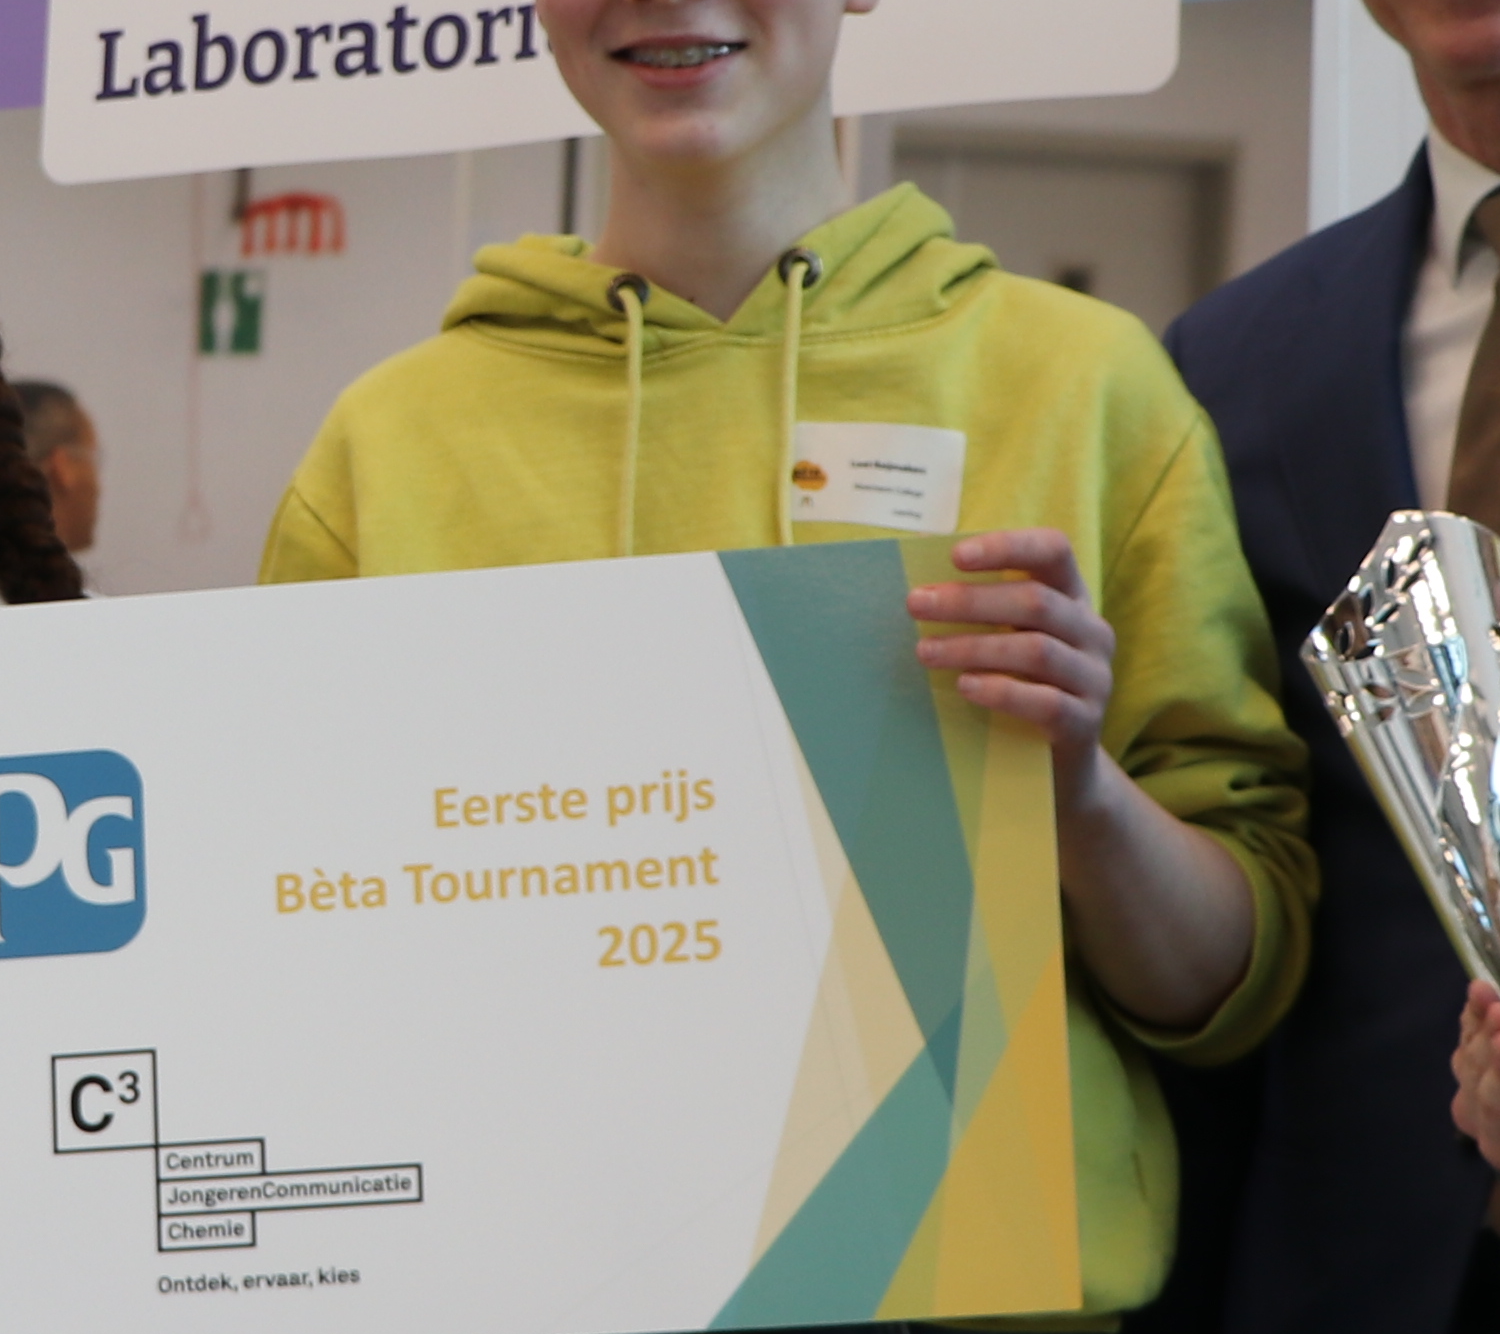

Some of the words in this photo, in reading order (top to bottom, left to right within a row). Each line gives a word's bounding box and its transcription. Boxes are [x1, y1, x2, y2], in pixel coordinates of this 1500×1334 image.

[434, 783, 588, 829] Eerste
[606, 769, 717, 828] prijs
[275, 868, 388, 914] Bèta
[404, 847, 720, 905] Tournament
[598, 919, 723, 968] 2025
[166, 1149, 254, 1170] Centrum
[168, 1174, 412, 1207] JongerenCommunicatie
[168, 1219, 245, 1240] Chemie
[159, 1275, 239, 1294] Ontdek,
[243, 1271, 314, 1290] ervaar,
[319, 1267, 361, 1285] kies
